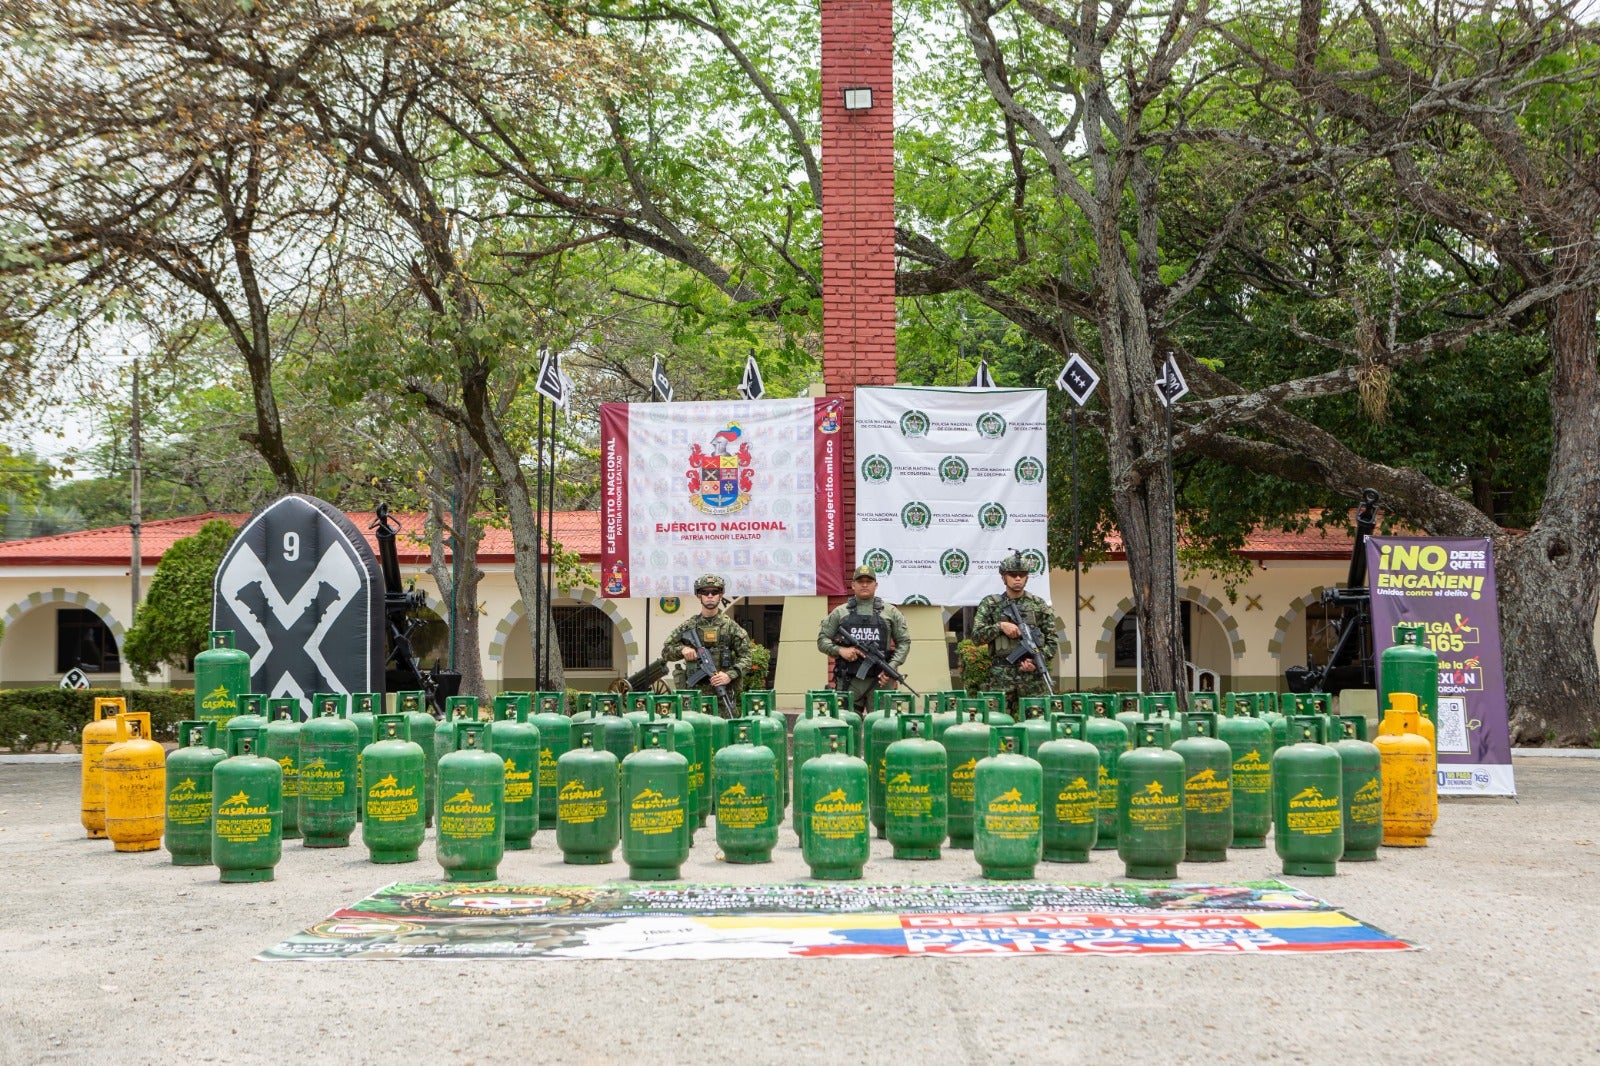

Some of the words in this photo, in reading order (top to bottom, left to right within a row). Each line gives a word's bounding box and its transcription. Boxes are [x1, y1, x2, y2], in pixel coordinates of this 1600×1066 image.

[607, 438, 615, 496] NACIONAL
[825, 440, 836, 551] www.ejercito.mil.co
[656, 521, 717, 532] EJÉRCITO
[721, 521, 786, 531] NACIONAL
[283, 532, 299, 561] 9
[1379, 545, 1447, 571] ¡NO
[1450, 551, 1485, 560] DEJES
[1450, 561, 1472, 570] QUE
[1473, 561, 1485, 569] TE
[1378, 571, 1484, 600] ENGAÑEN!
[1444, 589, 1468, 597] delito
[1428, 634, 1464, 652] 165
[1453, 661, 1463, 669] la
[909, 916, 1094, 926] DESDE
